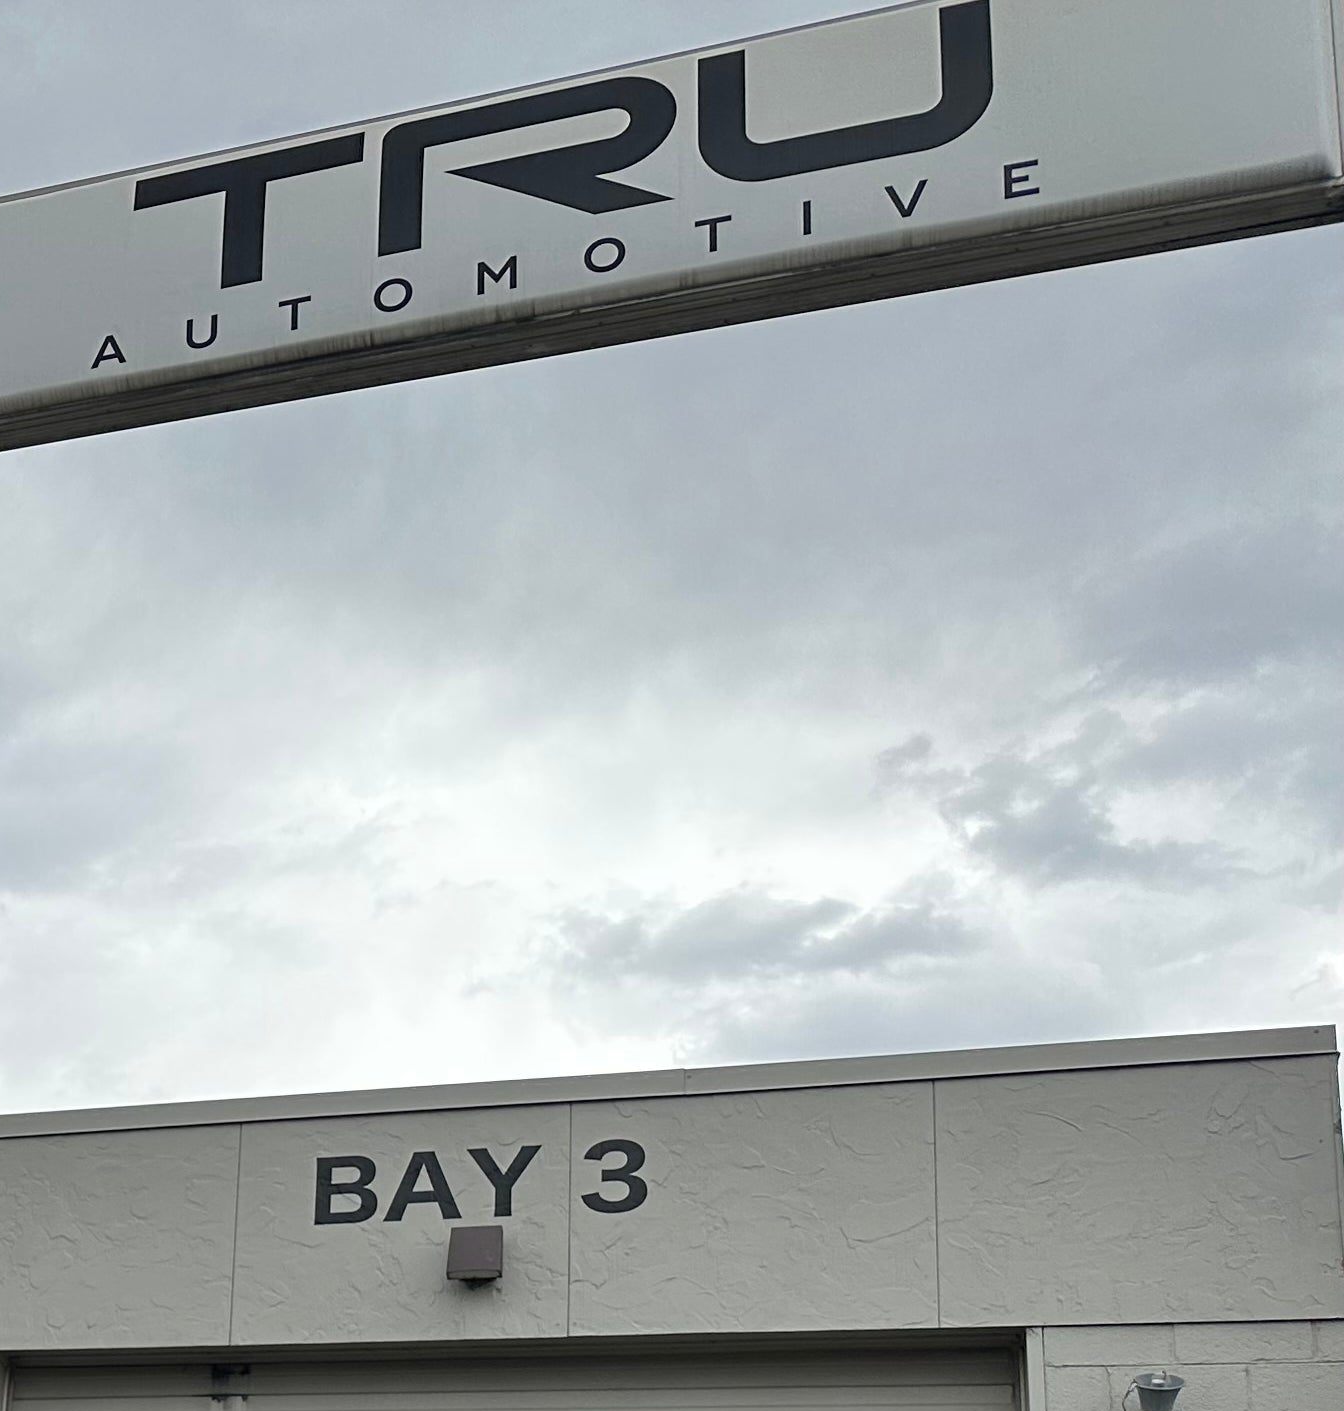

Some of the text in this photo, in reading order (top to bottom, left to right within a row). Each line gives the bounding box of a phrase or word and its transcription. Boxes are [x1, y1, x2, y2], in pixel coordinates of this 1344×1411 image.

[133, 0, 993, 288] TRU
[91, 159, 1039, 369] AUTOMOTIVE
[314, 1139, 648, 1225] BAY 3
